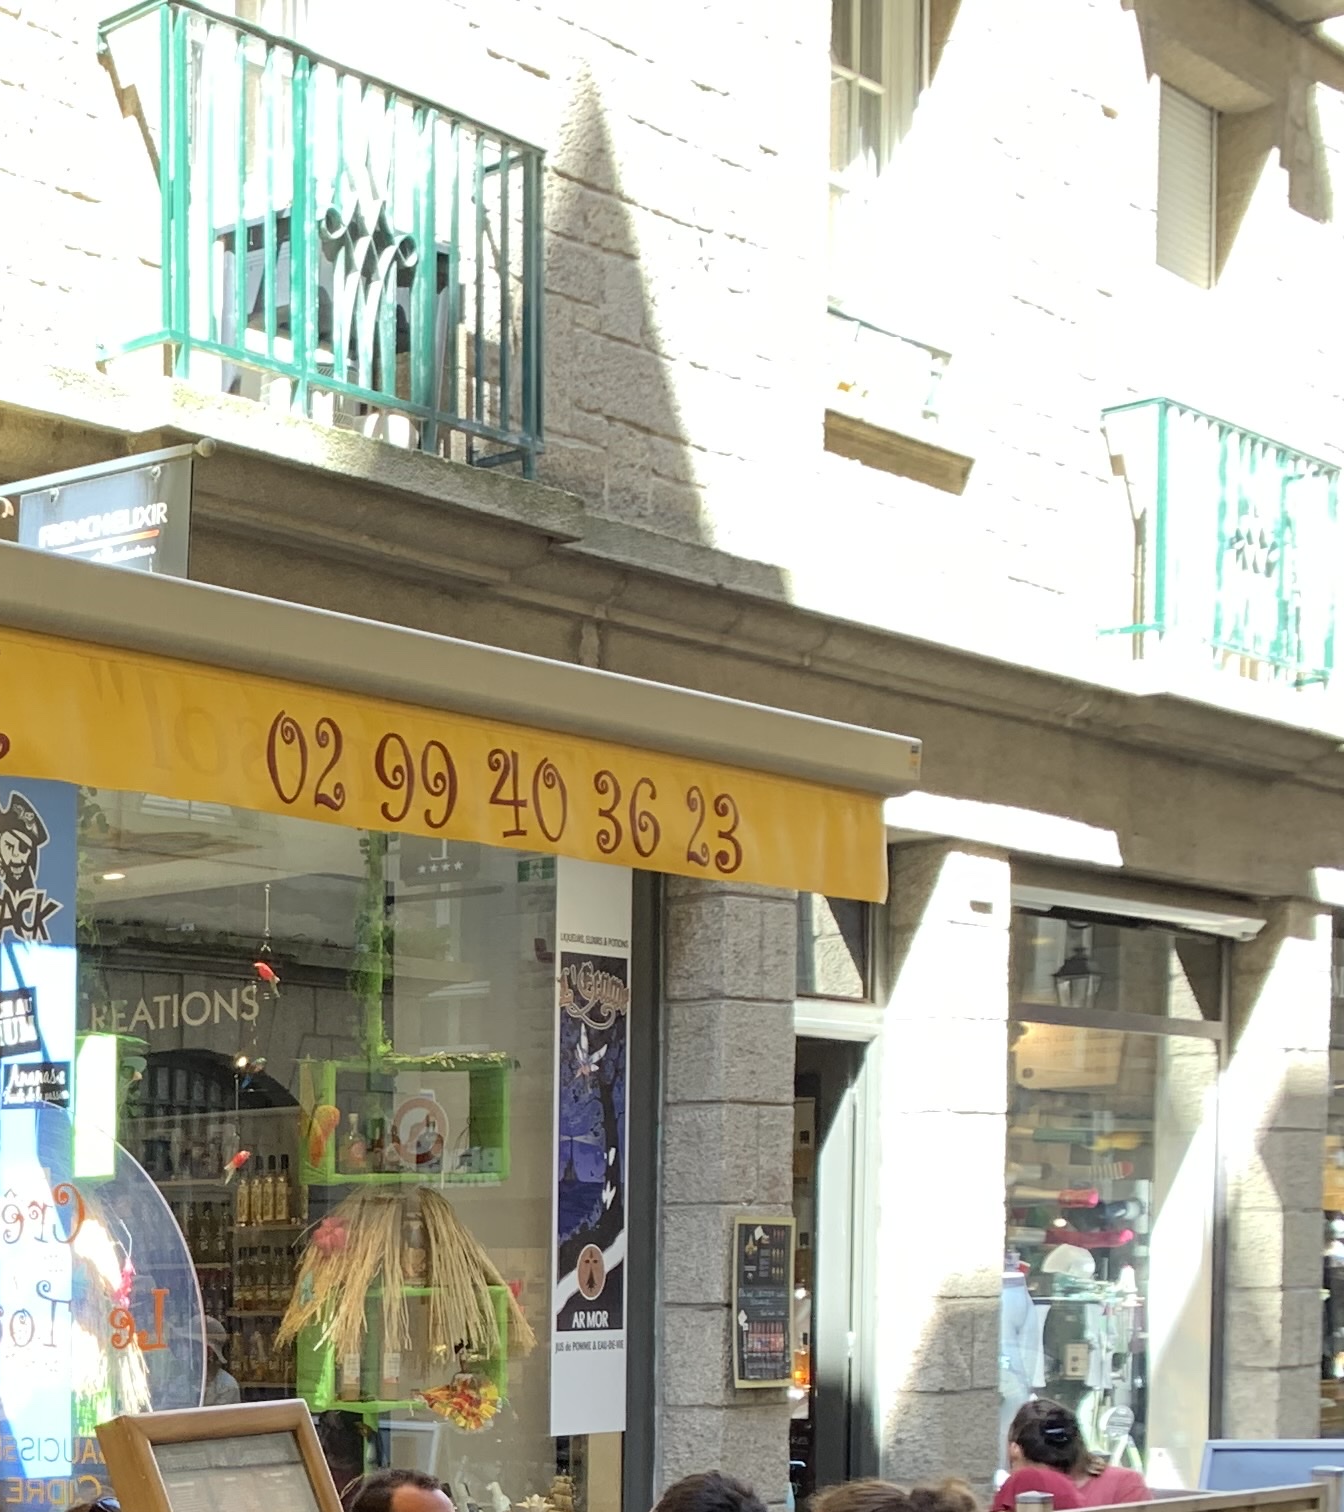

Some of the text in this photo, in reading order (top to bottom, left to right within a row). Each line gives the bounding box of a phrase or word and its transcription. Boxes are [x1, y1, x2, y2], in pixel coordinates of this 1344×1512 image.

[115, 502, 169, 534] ELIXIR
[266, 711, 345, 812] 02
[374, 732, 458, 829] 99
[487, 748, 568, 842] 40
[593, 769, 661, 859] 36
[685, 784, 743, 874] 23
[90, 985, 260, 1033] REATIONS
